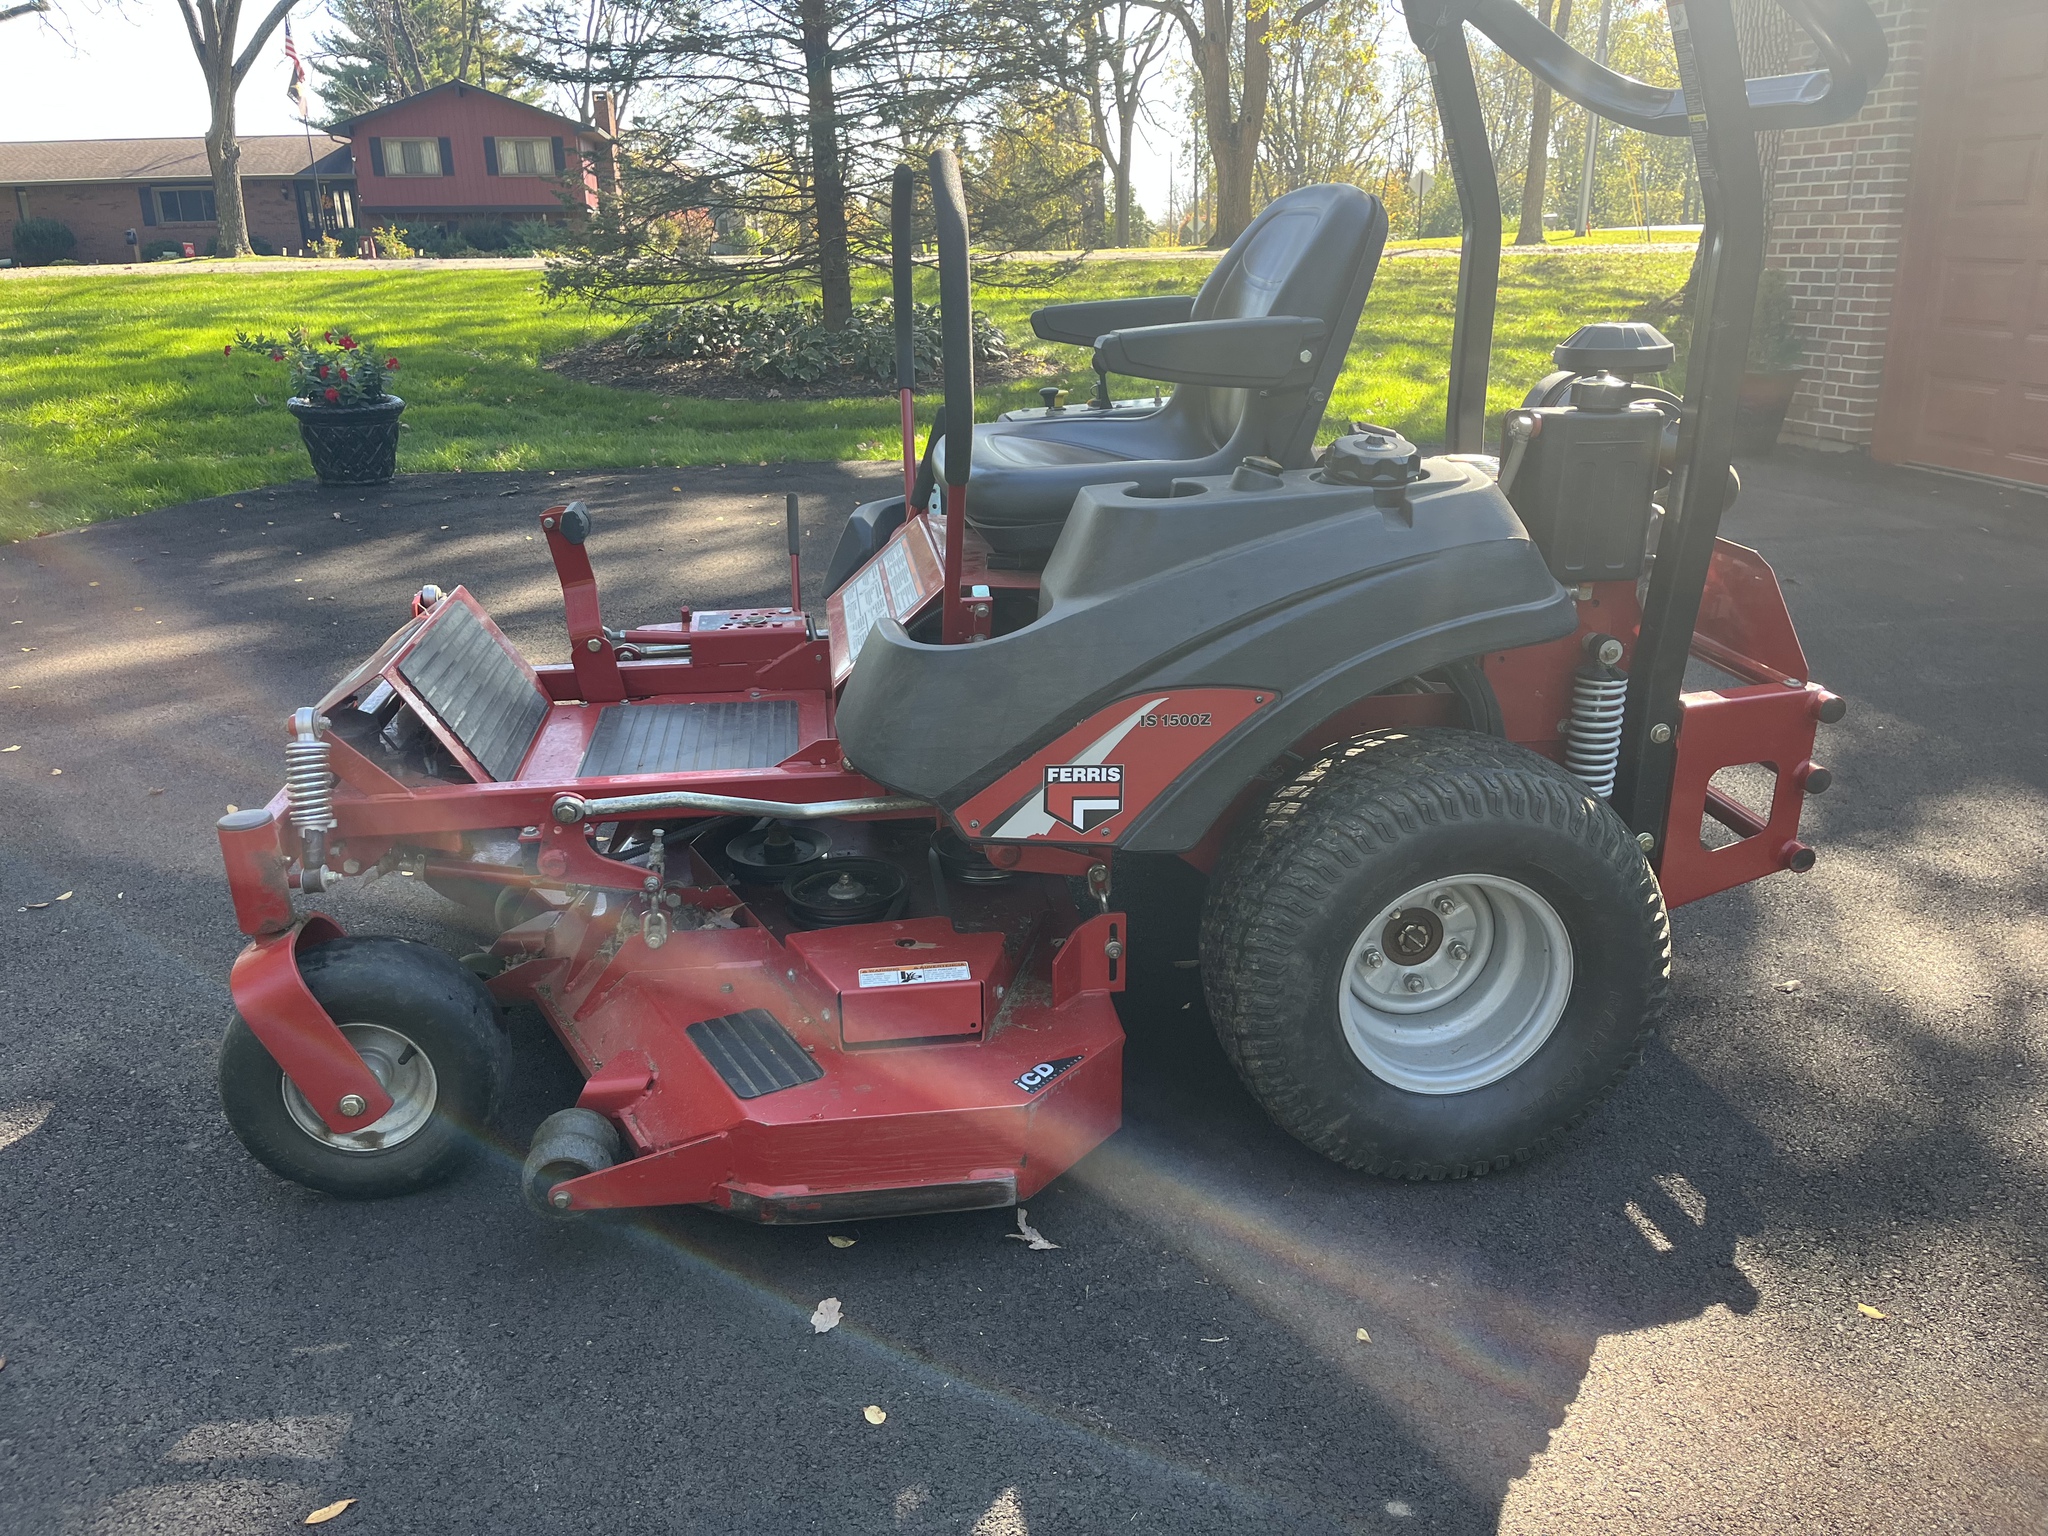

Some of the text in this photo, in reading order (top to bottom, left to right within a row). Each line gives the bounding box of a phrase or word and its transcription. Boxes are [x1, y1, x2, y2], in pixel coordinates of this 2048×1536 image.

[1140, 713, 1212, 727] IS 1500Z
[1047, 767, 1121, 782] FERRIS
